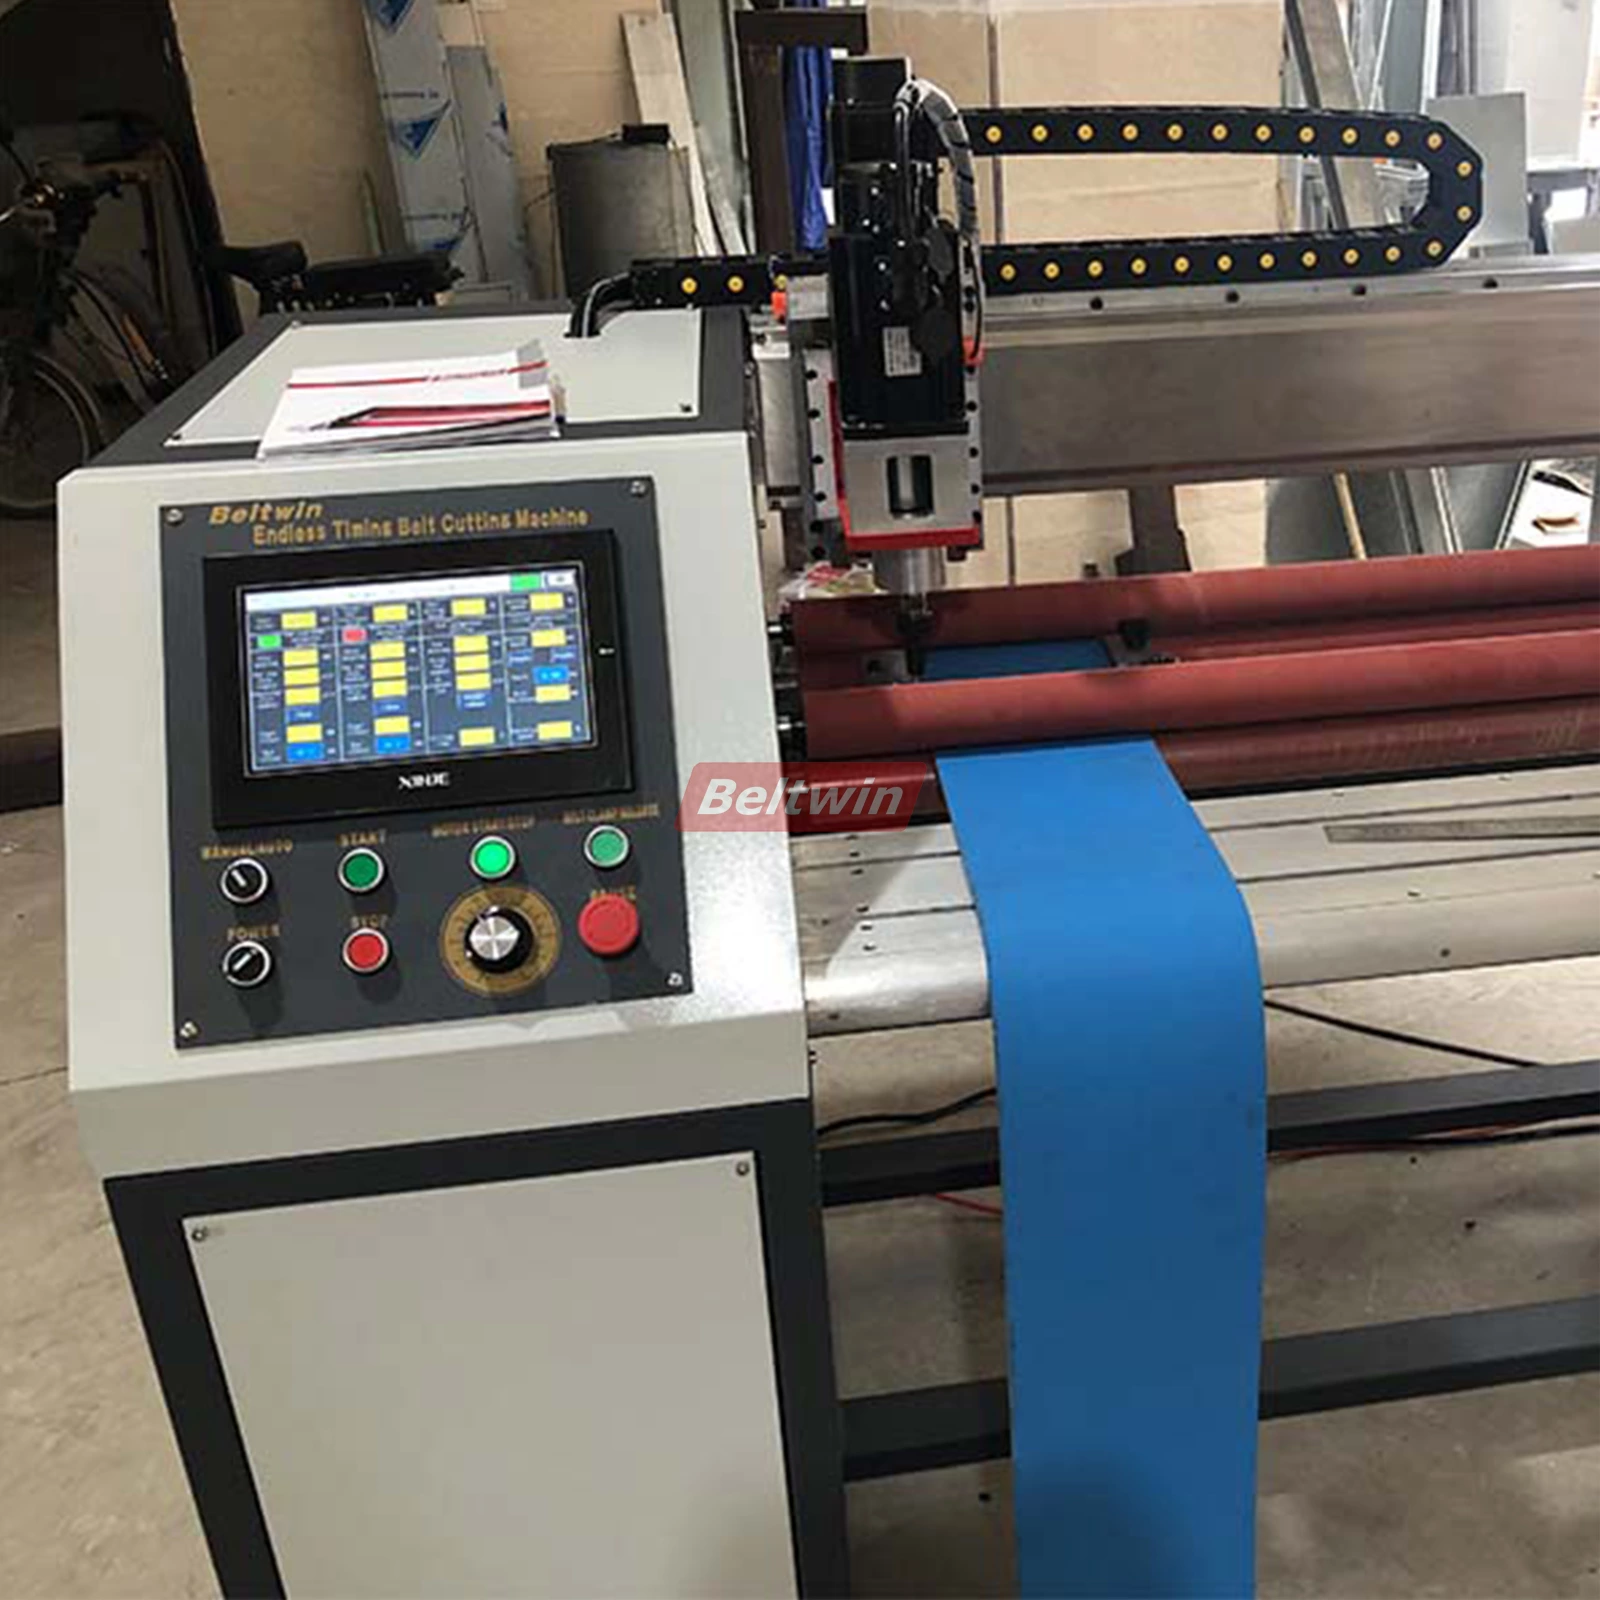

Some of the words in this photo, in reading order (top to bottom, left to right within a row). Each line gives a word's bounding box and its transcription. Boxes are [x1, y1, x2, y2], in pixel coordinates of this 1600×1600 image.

[208, 501, 324, 526] Beltwin
[252, 522, 327, 546] Endless
[332, 516, 393, 541] Timing
[397, 514, 436, 538] Belt
[440, 510, 512, 535] Cutting
[515, 505, 589, 530] Machine
